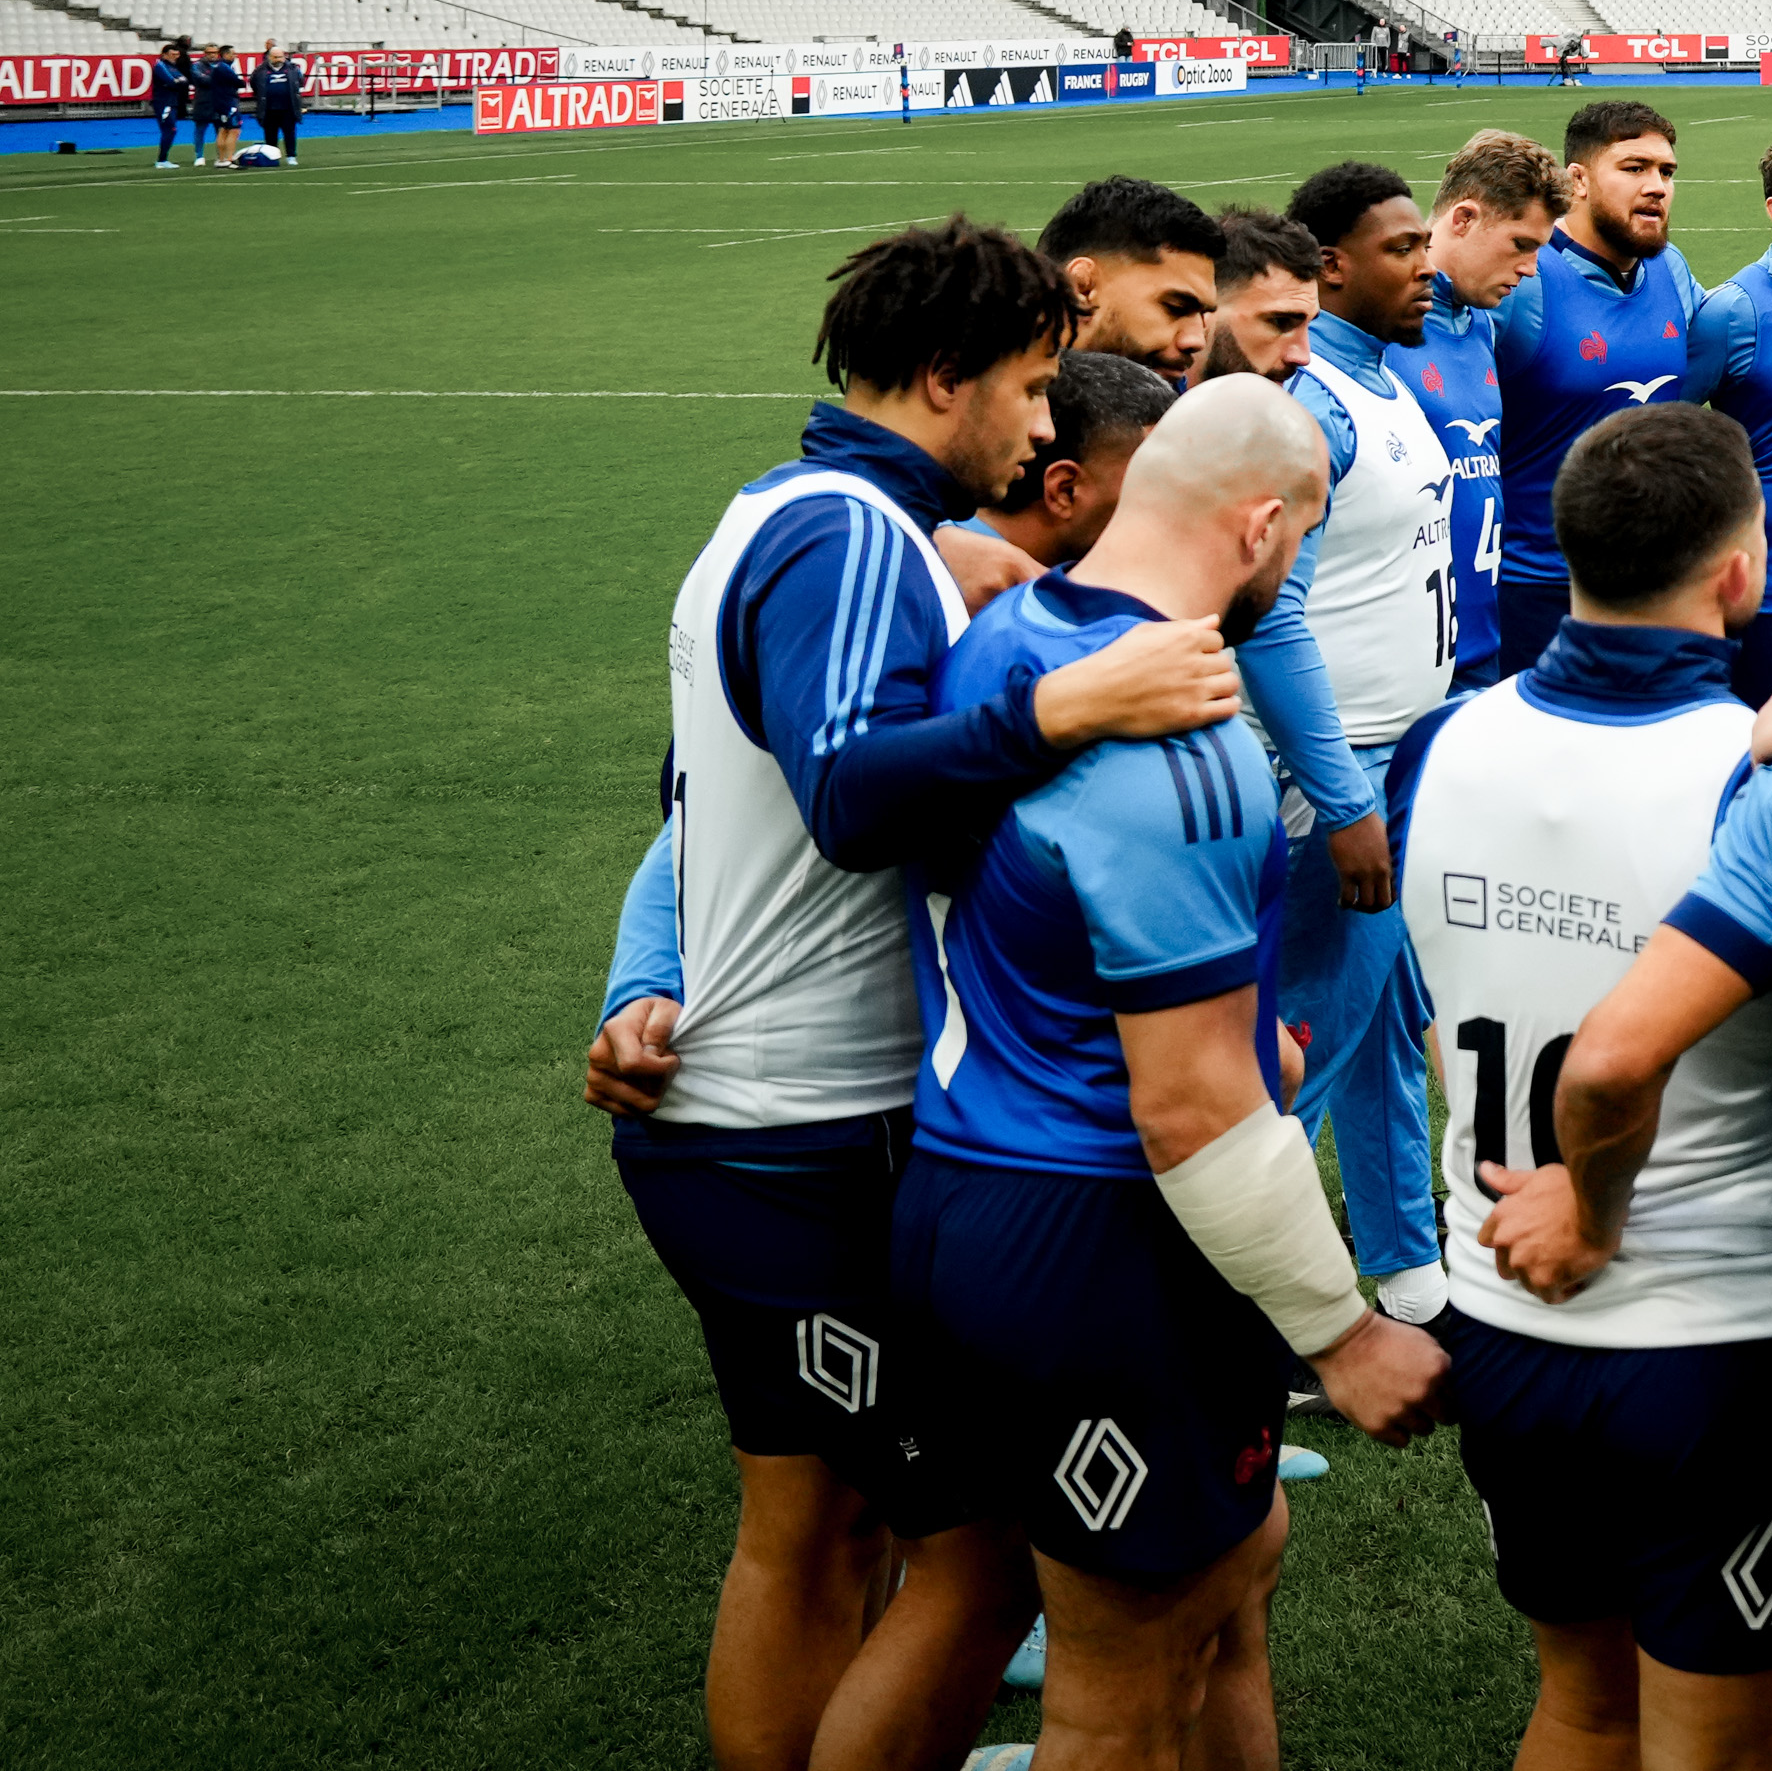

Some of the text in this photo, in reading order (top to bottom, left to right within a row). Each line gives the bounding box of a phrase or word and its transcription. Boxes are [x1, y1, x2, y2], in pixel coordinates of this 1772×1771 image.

[1002, 49, 1049, 60] RENAULT
[1628, 38, 1687, 58] TCL
[585, 59, 635, 72] RENAULT
[0, 58, 152, 99] ALTRAD
[700, 78, 763, 97] SOCIETE
[1065, 73, 1149, 89] FRANCE RUGBY
[1177, 65, 1232, 91] Optic 2000
[833, 85, 877, 100] RENAULT
[507, 85, 633, 129] ALTRAD
[700, 98, 778, 119] GENERALE
[1497, 883, 1620, 922] SOCIETE
[1497, 909, 1648, 954] GENERALE
